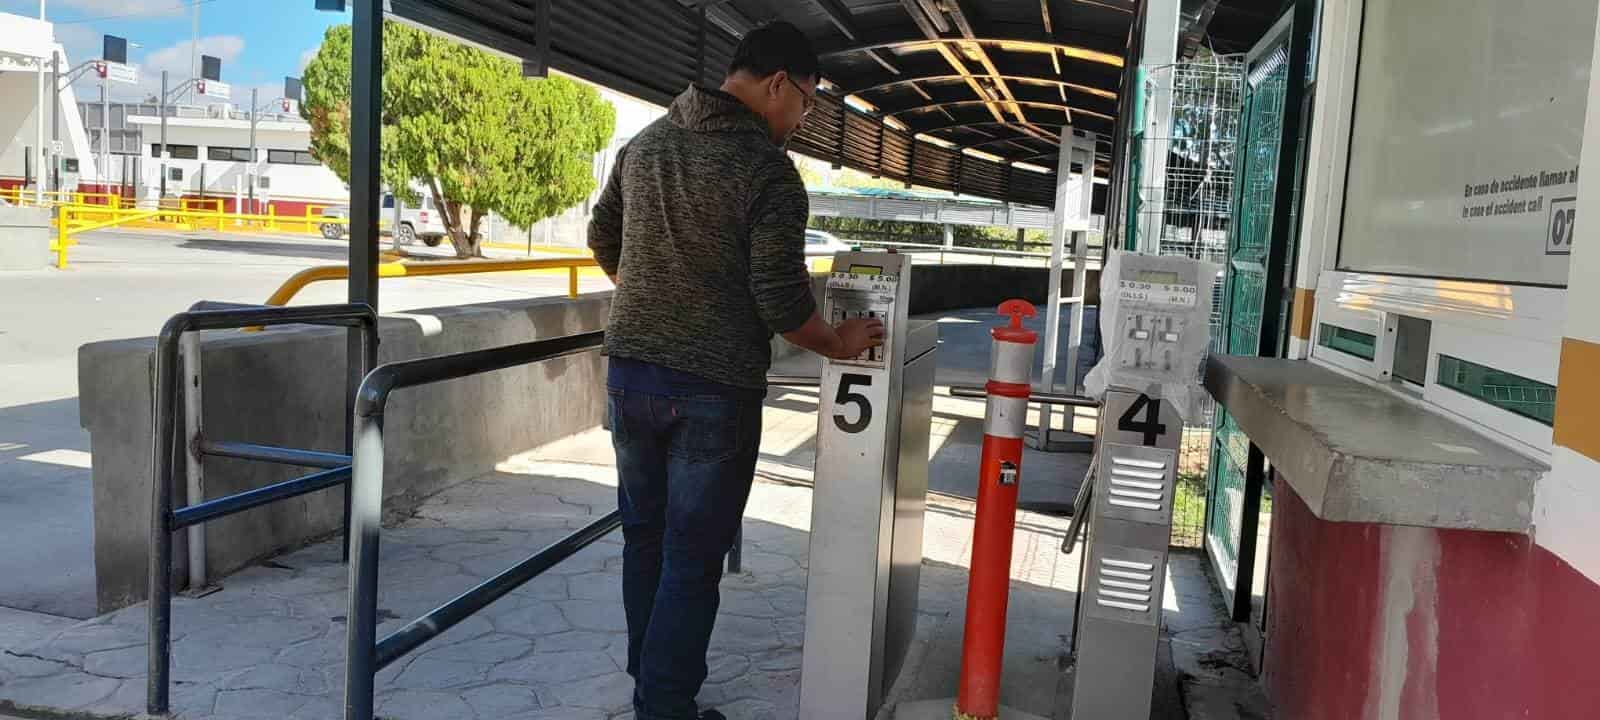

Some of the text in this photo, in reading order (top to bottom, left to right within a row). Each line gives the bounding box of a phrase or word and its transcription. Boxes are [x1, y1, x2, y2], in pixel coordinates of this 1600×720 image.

[1464, 184, 1473, 198] En
[1490, 179, 1499, 194] de
[1500, 174, 1538, 193] accidente
[1539, 170, 1568, 187] llamar
[1494, 199, 1527, 215] accident
[1527, 195, 1544, 212] call
[833, 373, 872, 433] 5
[1118, 387, 1166, 446] 4
